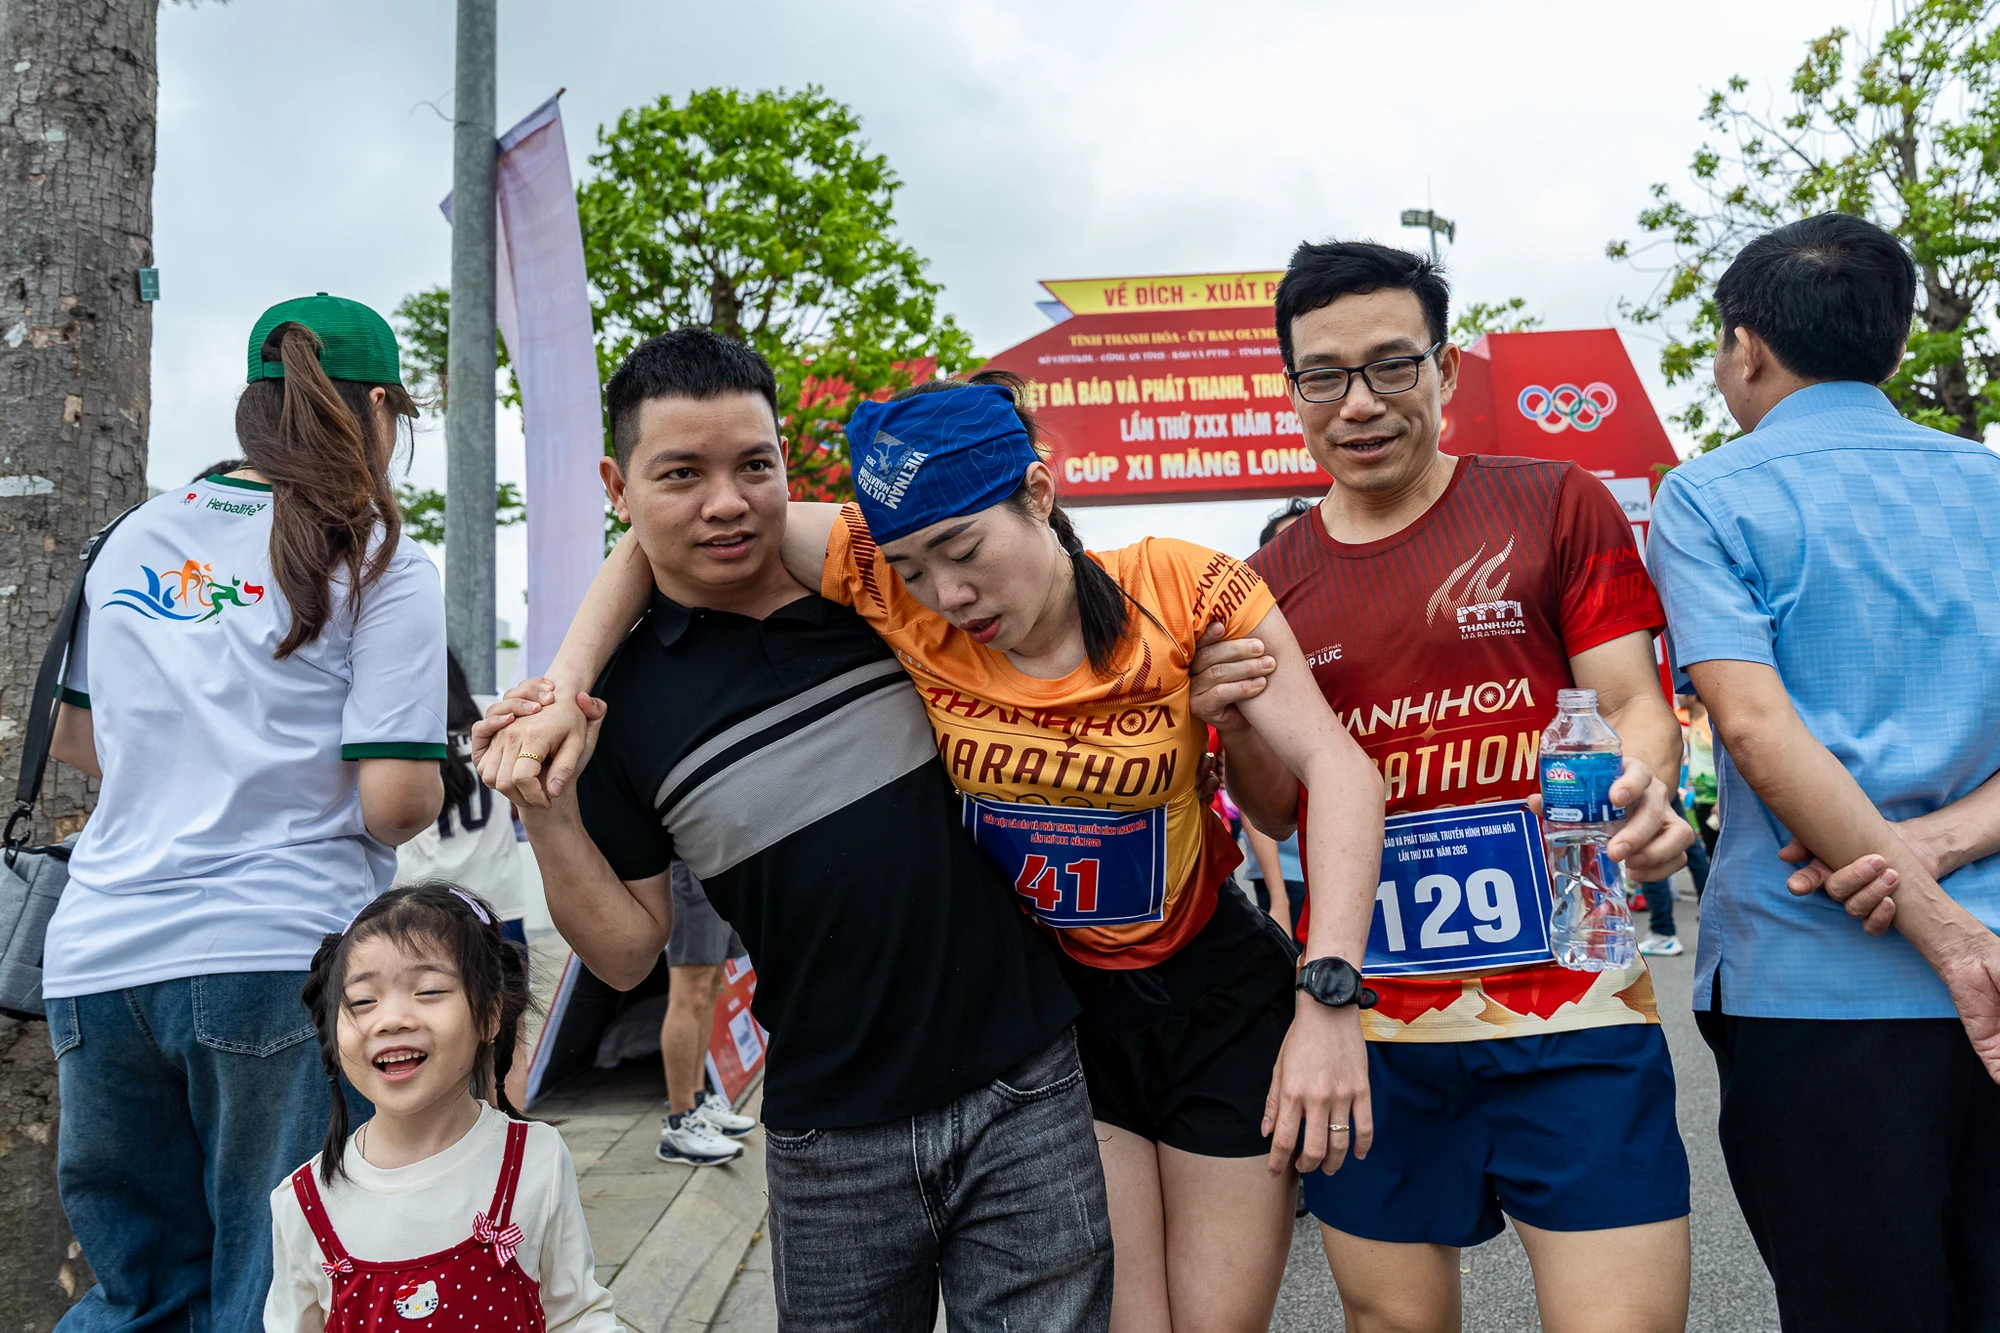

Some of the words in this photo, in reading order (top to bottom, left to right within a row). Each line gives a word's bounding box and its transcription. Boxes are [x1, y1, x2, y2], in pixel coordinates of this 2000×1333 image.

[1135, 282, 1184, 305] ĐÍCH
[1205, 274, 1256, 303] XUẤT
[1103, 333, 1150, 345] THANH
[1207, 329, 1235, 342] BAN
[1050, 377, 1076, 407] DÃ
[1077, 375, 1113, 406] BÁO
[1115, 374, 1140, 404] VÀ
[1141, 373, 1185, 403] PHÁT
[1187, 375, 1249, 401] THANH,
[1251, 373, 1290, 398] TRU
[1193, 413, 1228, 438] XXX
[1231, 408, 1272, 437] NĂM
[1274, 411, 1304, 436] 202
[859, 466, 892, 494] MARATHON
[884, 451, 929, 510] VIETNAM
[1065, 451, 1119, 484] CÚP
[1125, 454, 1153, 481] XI
[1160, 447, 1241, 479] MĂNG
[1246, 447, 1317, 476] LONG
[858, 474, 887, 503] ULTRA
[206, 497, 257, 516] Herbalife
[1585, 543, 1640, 574] THAN
[1211, 563, 1261, 627] ARATH
[1586, 572, 1647, 613] MARA
[1458, 621, 1501, 633] THANH
[1501, 618, 1525, 628] HÓA
[1461, 629, 1511, 640] MARATHON
[1317, 648, 1343, 666] LỰC
[1337, 692, 1434, 737] ANH
[1374, 730, 1540, 802] ATHON
[1040, 821, 1055, 832] PHÁT
[1101, 825, 1117, 836] HÌNH
[1403, 833, 1418, 846] PHÁT
[1465, 826, 1481, 838] HÌNH
[1480, 825, 1502, 836] THANH
[1502, 821, 1517, 834] HÓA
[1422, 848, 1434, 859] XXX
[1436, 845, 1452, 857] NĂM
[1452, 844, 1468, 856] 2026
[1014, 854, 1100, 912] 41
[1375, 868, 1521, 952] 129
